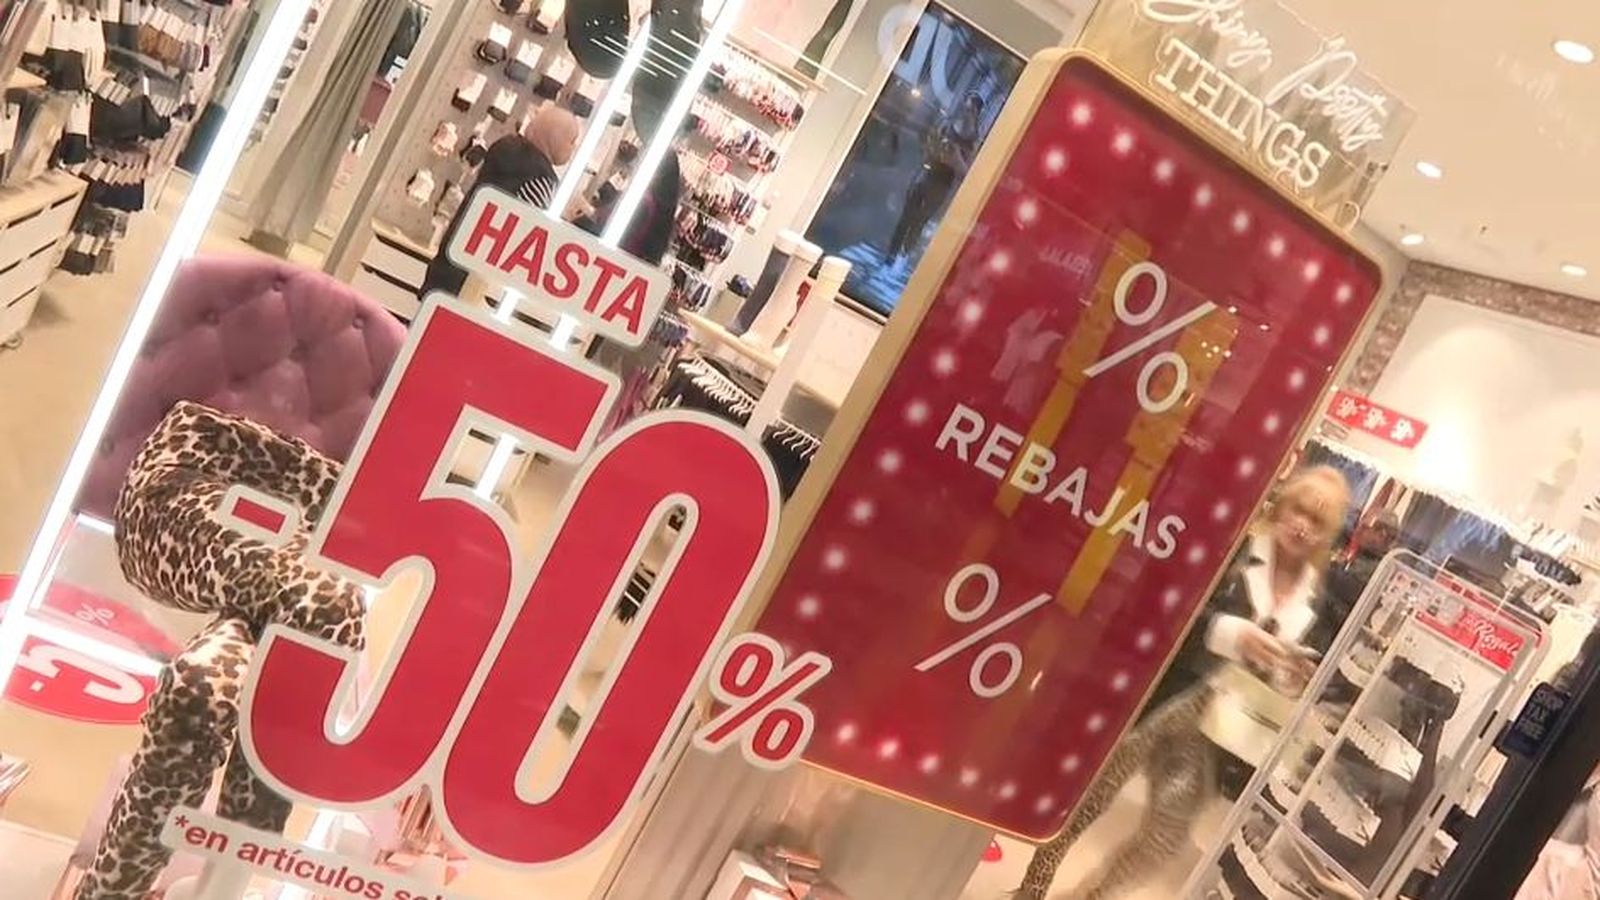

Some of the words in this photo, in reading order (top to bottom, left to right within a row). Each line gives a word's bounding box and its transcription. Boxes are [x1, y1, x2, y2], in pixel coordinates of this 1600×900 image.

[1155, 38, 1331, 188] THINGS
[464, 201, 649, 335] HASTA
[1083, 261, 1218, 413] %
[935, 403, 1186, 559] REBAJAS
[913, 563, 1052, 698] %
[237, 841, 384, 899] artículos
